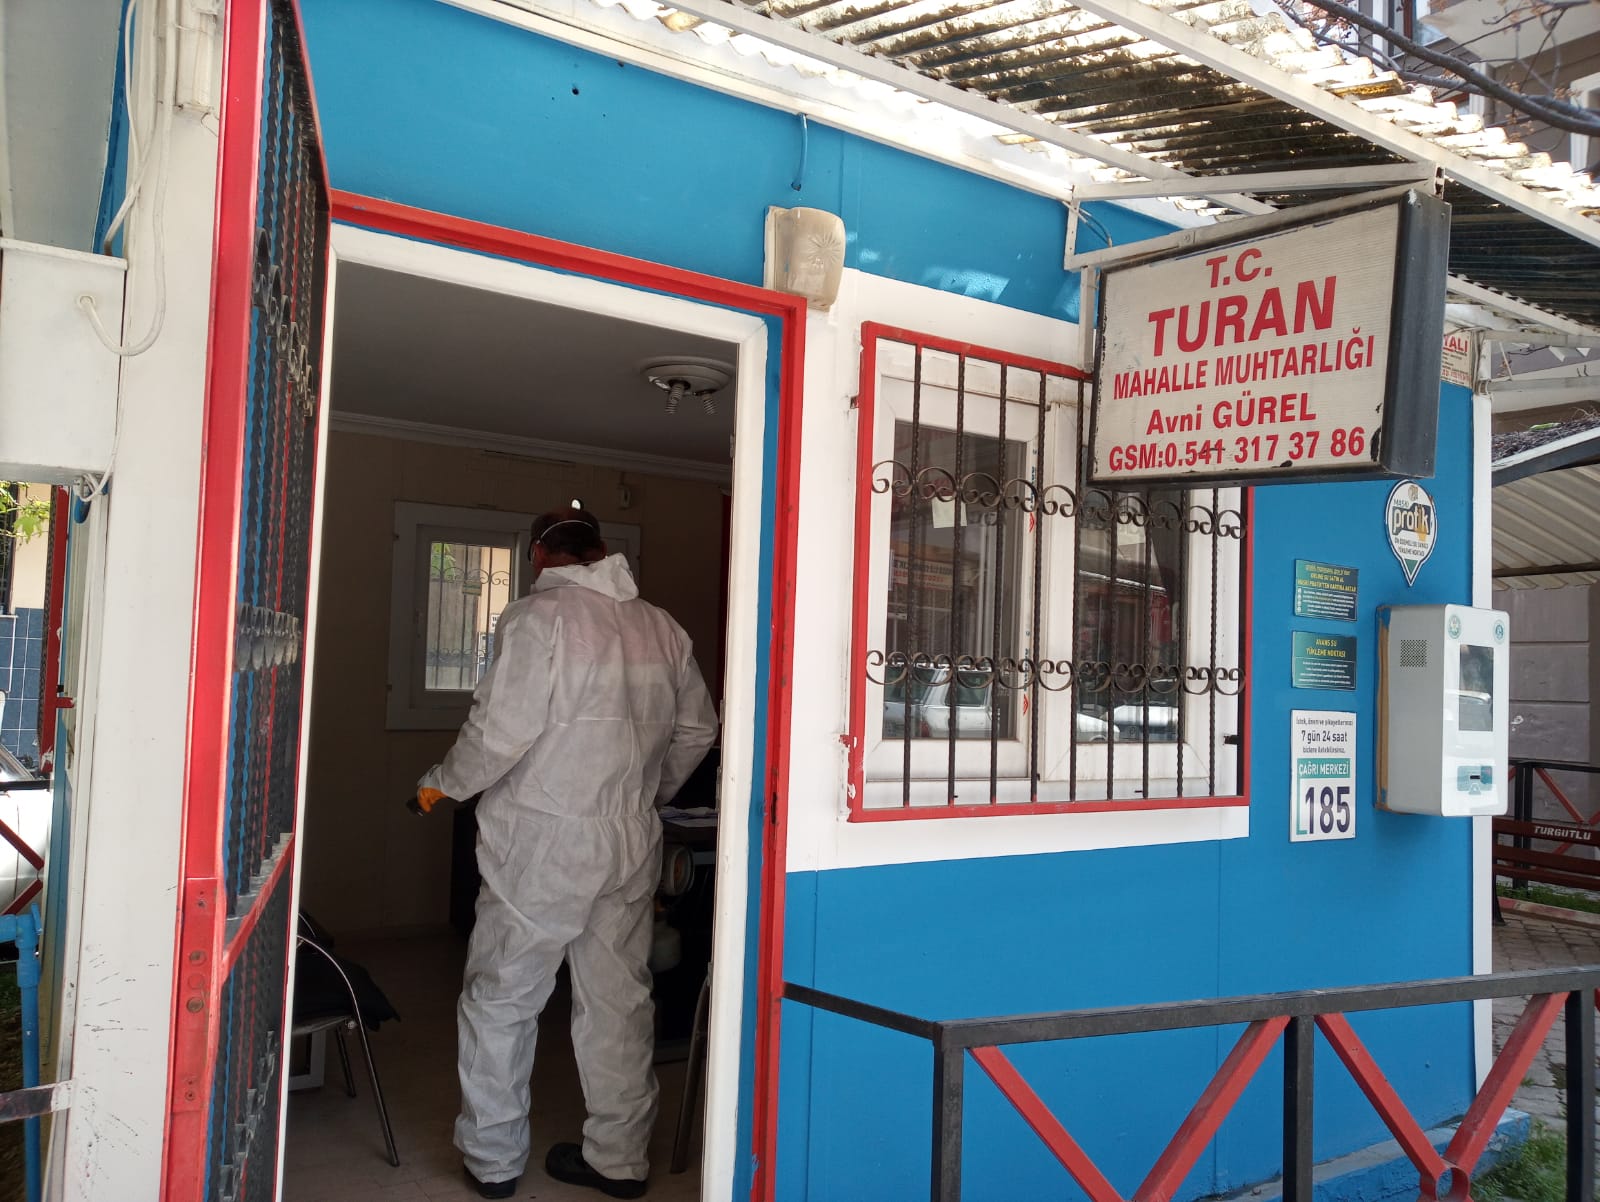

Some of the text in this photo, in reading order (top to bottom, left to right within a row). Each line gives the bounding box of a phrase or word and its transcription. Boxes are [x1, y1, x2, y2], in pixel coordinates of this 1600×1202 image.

[1206, 248, 1272, 288] T.C.
[1148, 276, 1337, 357] TURAN
[1113, 327, 1375, 400] MAHALLE MUHTARLIĞI
[1146, 390, 1317, 435] Avni GÜREL
[1234, 435, 1280, 464] 317
[1288, 431, 1320, 460] 37
[1330, 426, 1365, 457] 86
[1301, 729, 1347, 744] 7 gün 24 saat
[1299, 761, 1349, 776] ÇAĞRI MERKEZİ
[1305, 786, 1350, 834] 185
[1535, 825, 1591, 841] TURGUTLU
